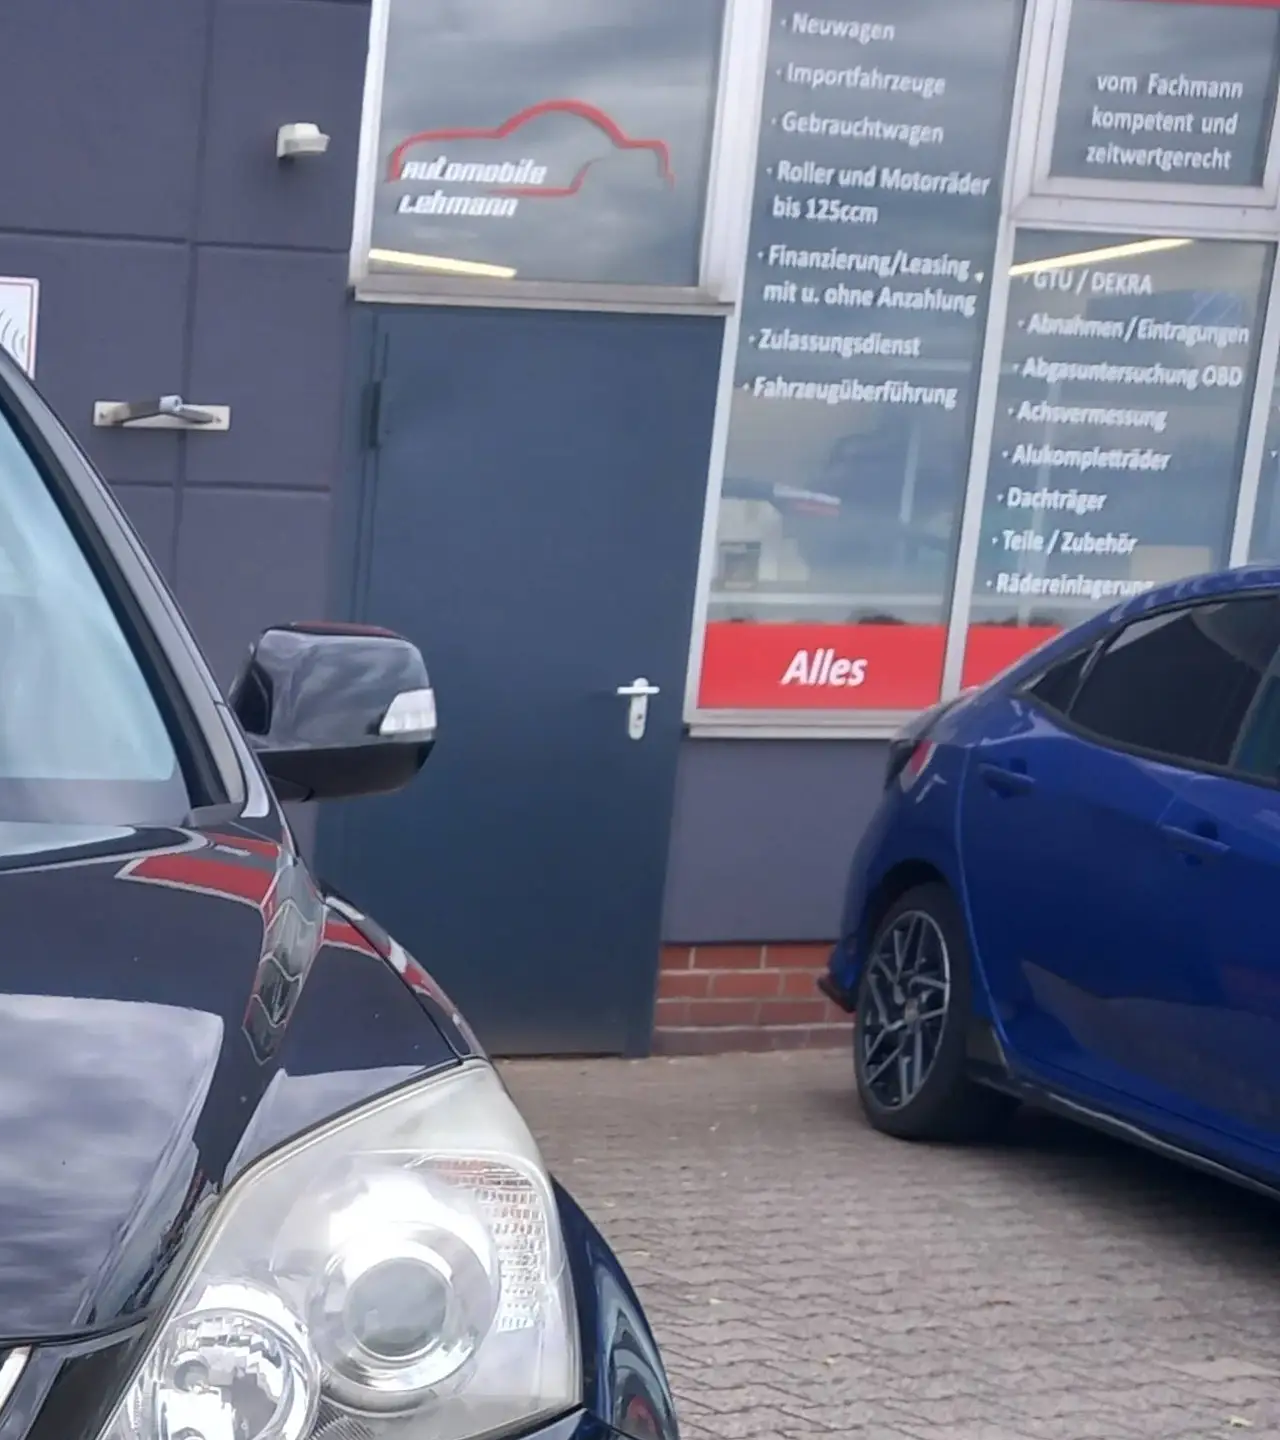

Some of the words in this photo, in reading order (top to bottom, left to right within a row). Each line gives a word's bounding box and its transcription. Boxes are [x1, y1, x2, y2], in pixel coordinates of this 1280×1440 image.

[792, 13, 895, 44] Neuwagen
[787, 62, 945, 98] Importfahrzeuge
[1097, 74, 1137, 94] vom
[1147, 73, 1243, 98] Fachmann
[781, 111, 944, 147] Gebrauchtwagen
[1092, 106, 1195, 134] kompetent
[1201, 113, 1239, 134] und
[1086, 143, 1232, 171] zeitwertgerecht
[777, 160, 834, 186] Roller
[839, 166, 876, 188] und
[880, 168, 991, 196] Motorräder
[398, 189, 520, 217] Lehmann
[772, 195, 801, 219] bis
[804, 198, 879, 224] 125ccm
[768, 244, 971, 282] Finanzierung/Leasing
[1091, 271, 1153, 296] DEKRA
[763, 281, 796, 303] mit
[801, 288, 820, 304] u.
[824, 284, 872, 307] ohne
[877, 289, 978, 318] Anzahlung
[758, 328, 921, 358] Zulassungsdienst
[1022, 356, 1199, 391] Abgasuntersuchung
[1202, 365, 1243, 388] OBD
[753, 376, 958, 409] Fahrzeugüberführung
[1016, 400, 1168, 433] Achsvermessung
[1012, 443, 1172, 472] Alukompletträder
[1007, 487, 1107, 515] Dachträger
[1002, 530, 1044, 552] Teile
[1060, 532, 1139, 555] Zubehör
[780, 648, 868, 686] Alles
